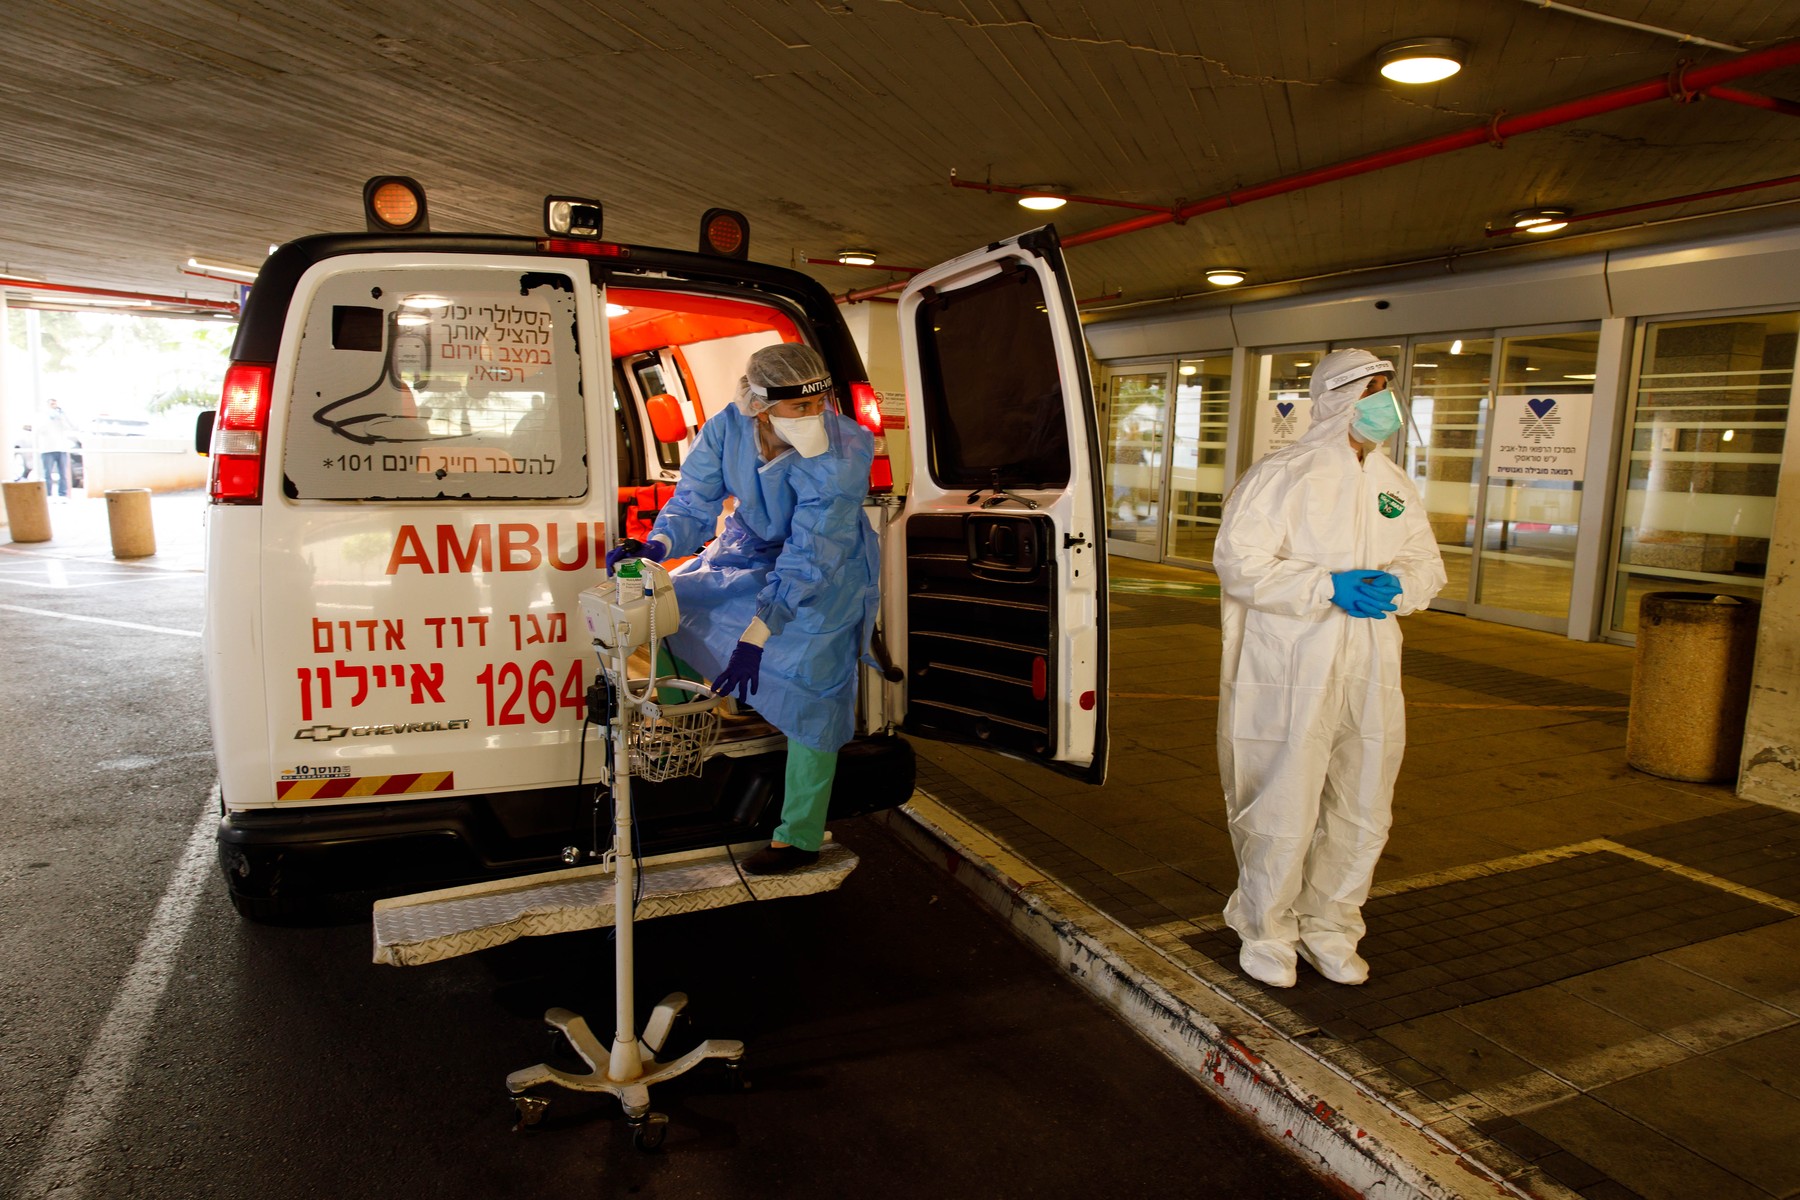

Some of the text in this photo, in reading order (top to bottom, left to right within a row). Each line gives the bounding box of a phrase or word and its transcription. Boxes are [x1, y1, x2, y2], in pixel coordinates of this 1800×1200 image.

[441, 303, 552, 326] הסלולרי יכול
[441, 323, 550, 345] להציל אותך
[441, 343, 492, 361] חירום
[499, 347, 552, 365] במצב
[1499, 445, 1528, 453] תל-אביב
[1553, 446, 1576, 454] המרכז
[382, 455, 431, 472] חינם
[439, 456, 477, 474] חייג
[485, 454, 556, 475] להסבר
[1524, 466, 1549, 475] מובילה
[1551, 468, 1573, 476] רפואה
[312, 612, 567, 654] מגן דוד אדום
[297, 659, 589, 727] איילון 1264
[351, 718, 472, 737] CHEVROLET
[295, 765, 309, 775] 10
[310, 766, 341, 776] מוסך
